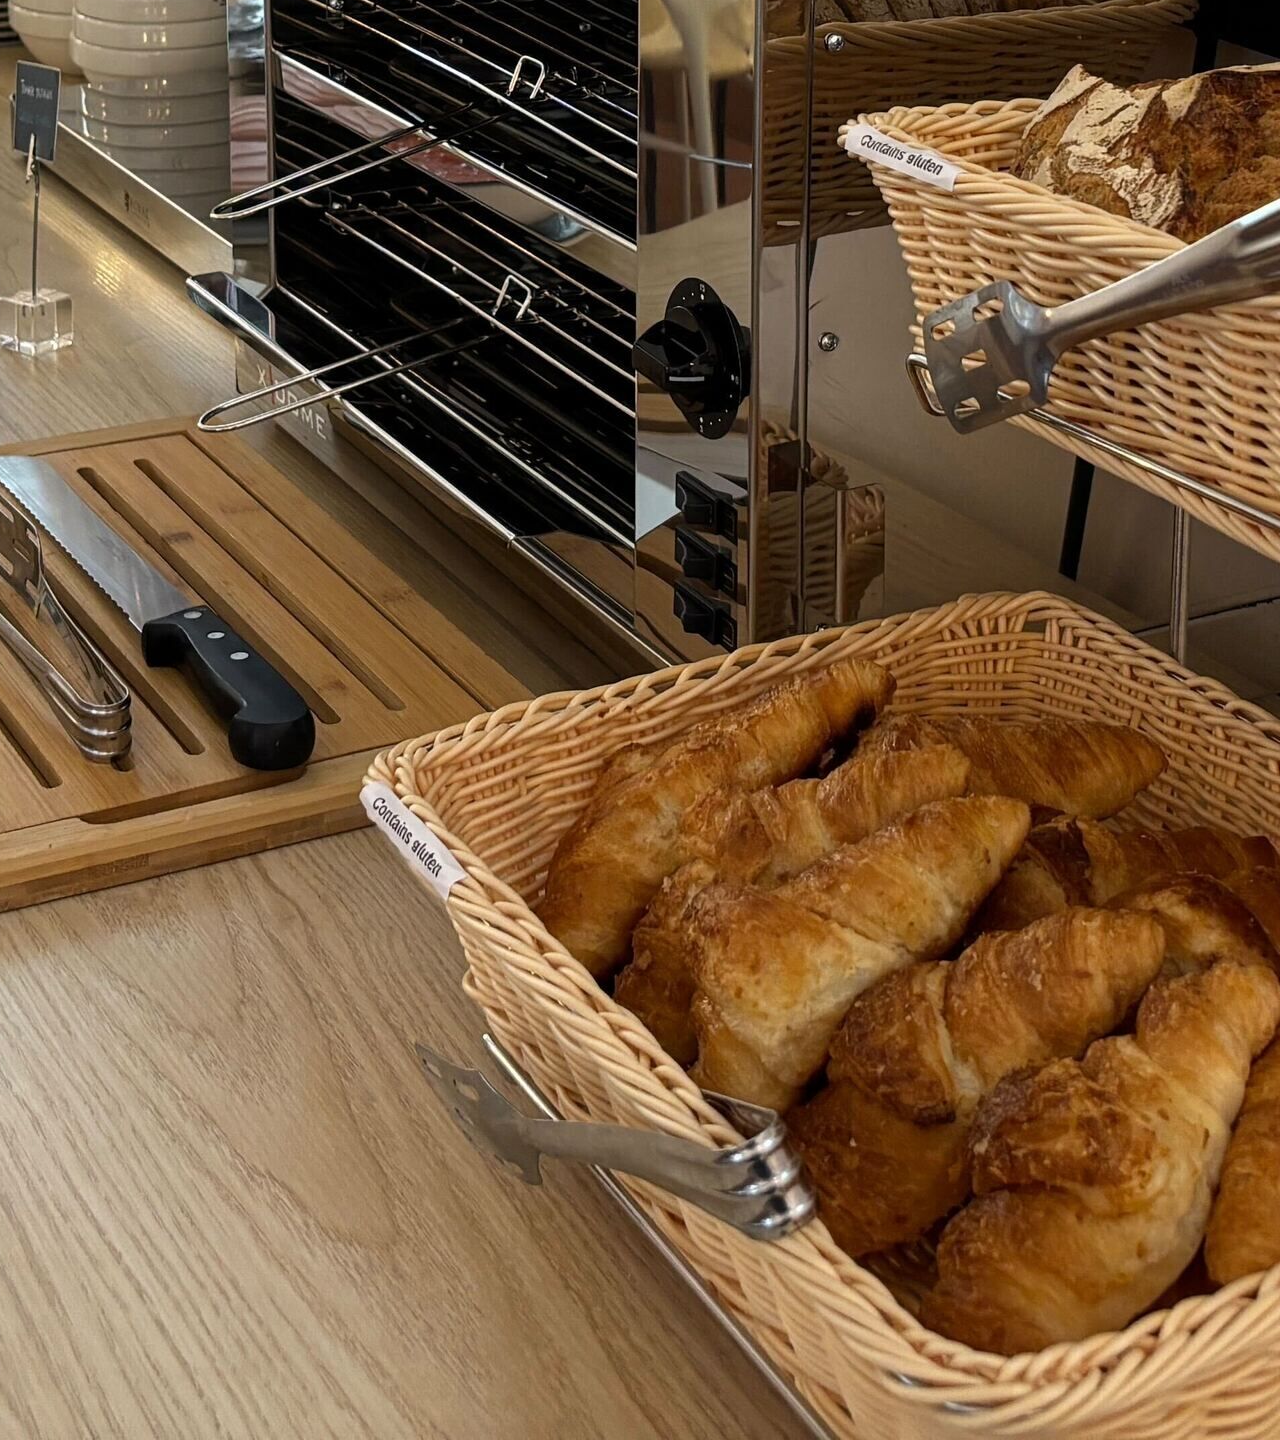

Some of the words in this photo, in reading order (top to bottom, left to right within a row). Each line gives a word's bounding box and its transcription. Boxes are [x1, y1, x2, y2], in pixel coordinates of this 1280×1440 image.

[861, 134, 906, 160] Contains
[906, 153, 944, 176] gluten
[373, 797, 412, 844] Contains
[411, 839, 442, 877] gluten
